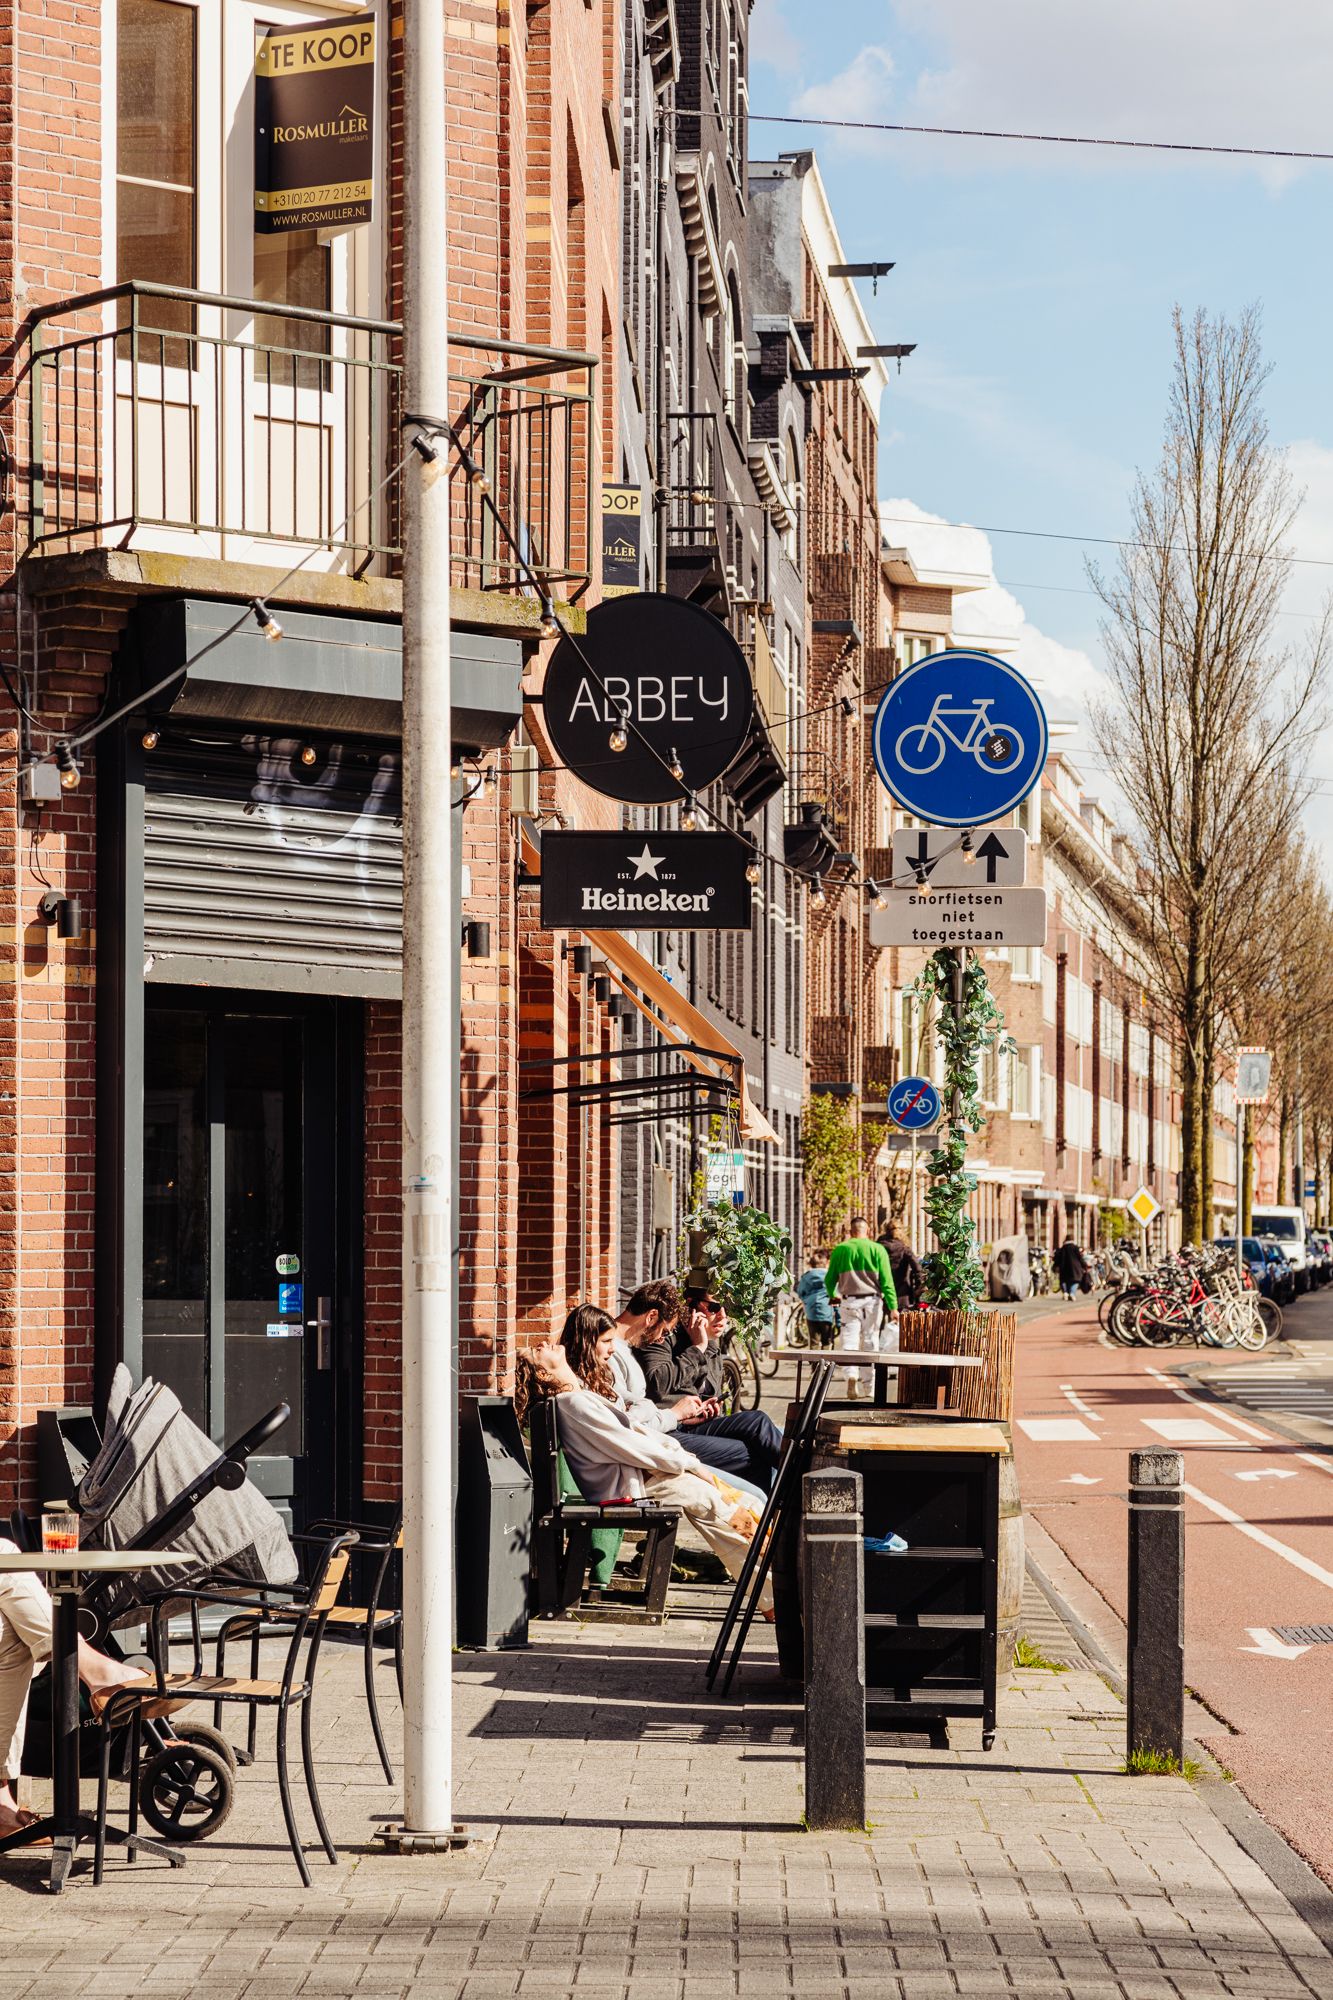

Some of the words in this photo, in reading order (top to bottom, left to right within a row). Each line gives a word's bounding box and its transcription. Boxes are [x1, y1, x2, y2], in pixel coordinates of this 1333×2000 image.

[271, 43, 294, 69] TE
[303, 32, 372, 64] KOOP
[273, 117, 368, 143] ROSMULLER
[318, 190, 330, 201] 77
[333, 187, 351, 200] 212
[354, 185, 366, 198] 54
[272, 206, 367, 226] WWW.ROSMULLER.NL
[568, 676, 728, 722] ABBEY
[909, 893, 1003, 905] snorfietsen
[942, 911, 975, 922] niet
[912, 928, 1004, 943] toegestaan
